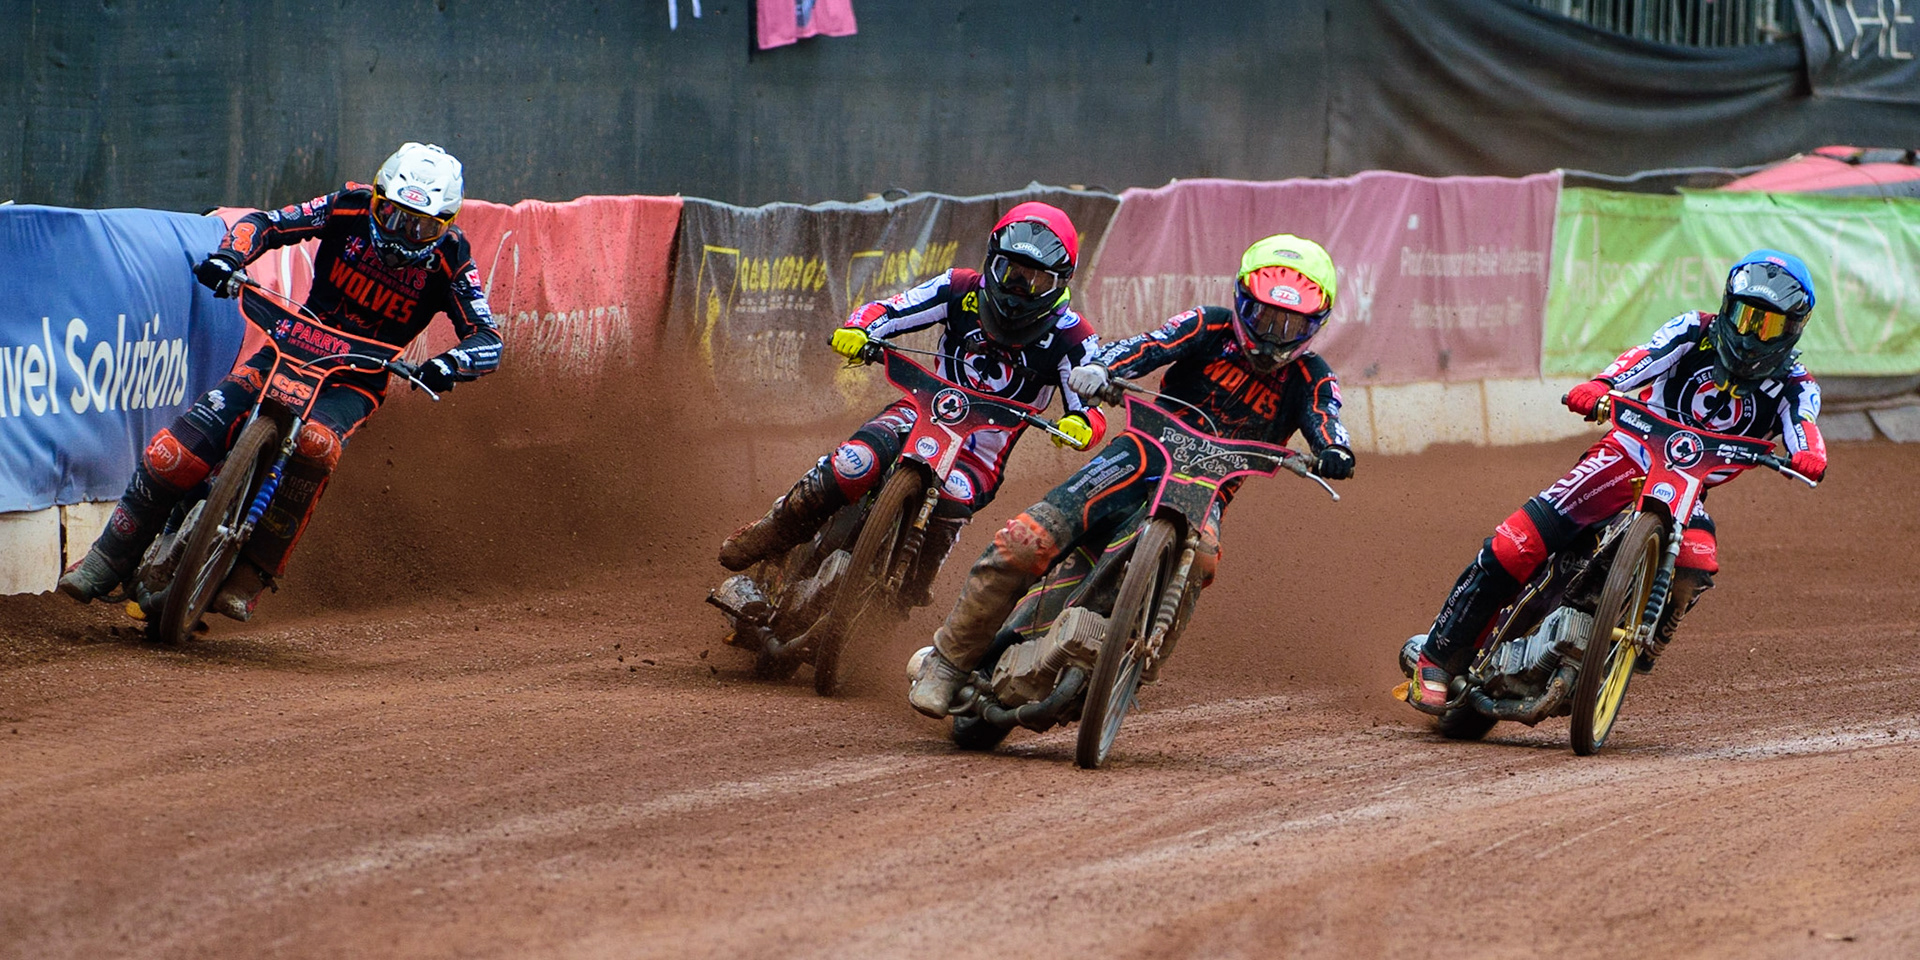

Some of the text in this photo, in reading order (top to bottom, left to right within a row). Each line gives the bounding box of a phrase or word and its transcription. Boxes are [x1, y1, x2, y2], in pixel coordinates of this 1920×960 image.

[361, 243, 428, 290] PRYS
[329, 256, 418, 324] WOLVES
[288, 337, 345, 364] INTERNATIAL
[291, 321, 352, 355] PARRYS
[0, 312, 189, 417] vel Solutions
[156, 443, 175, 464] ATPI
[845, 448, 864, 470] ATPI
[1655, 488, 1672, 498] ATPI
[1447, 564, 1479, 607] Grohmann
